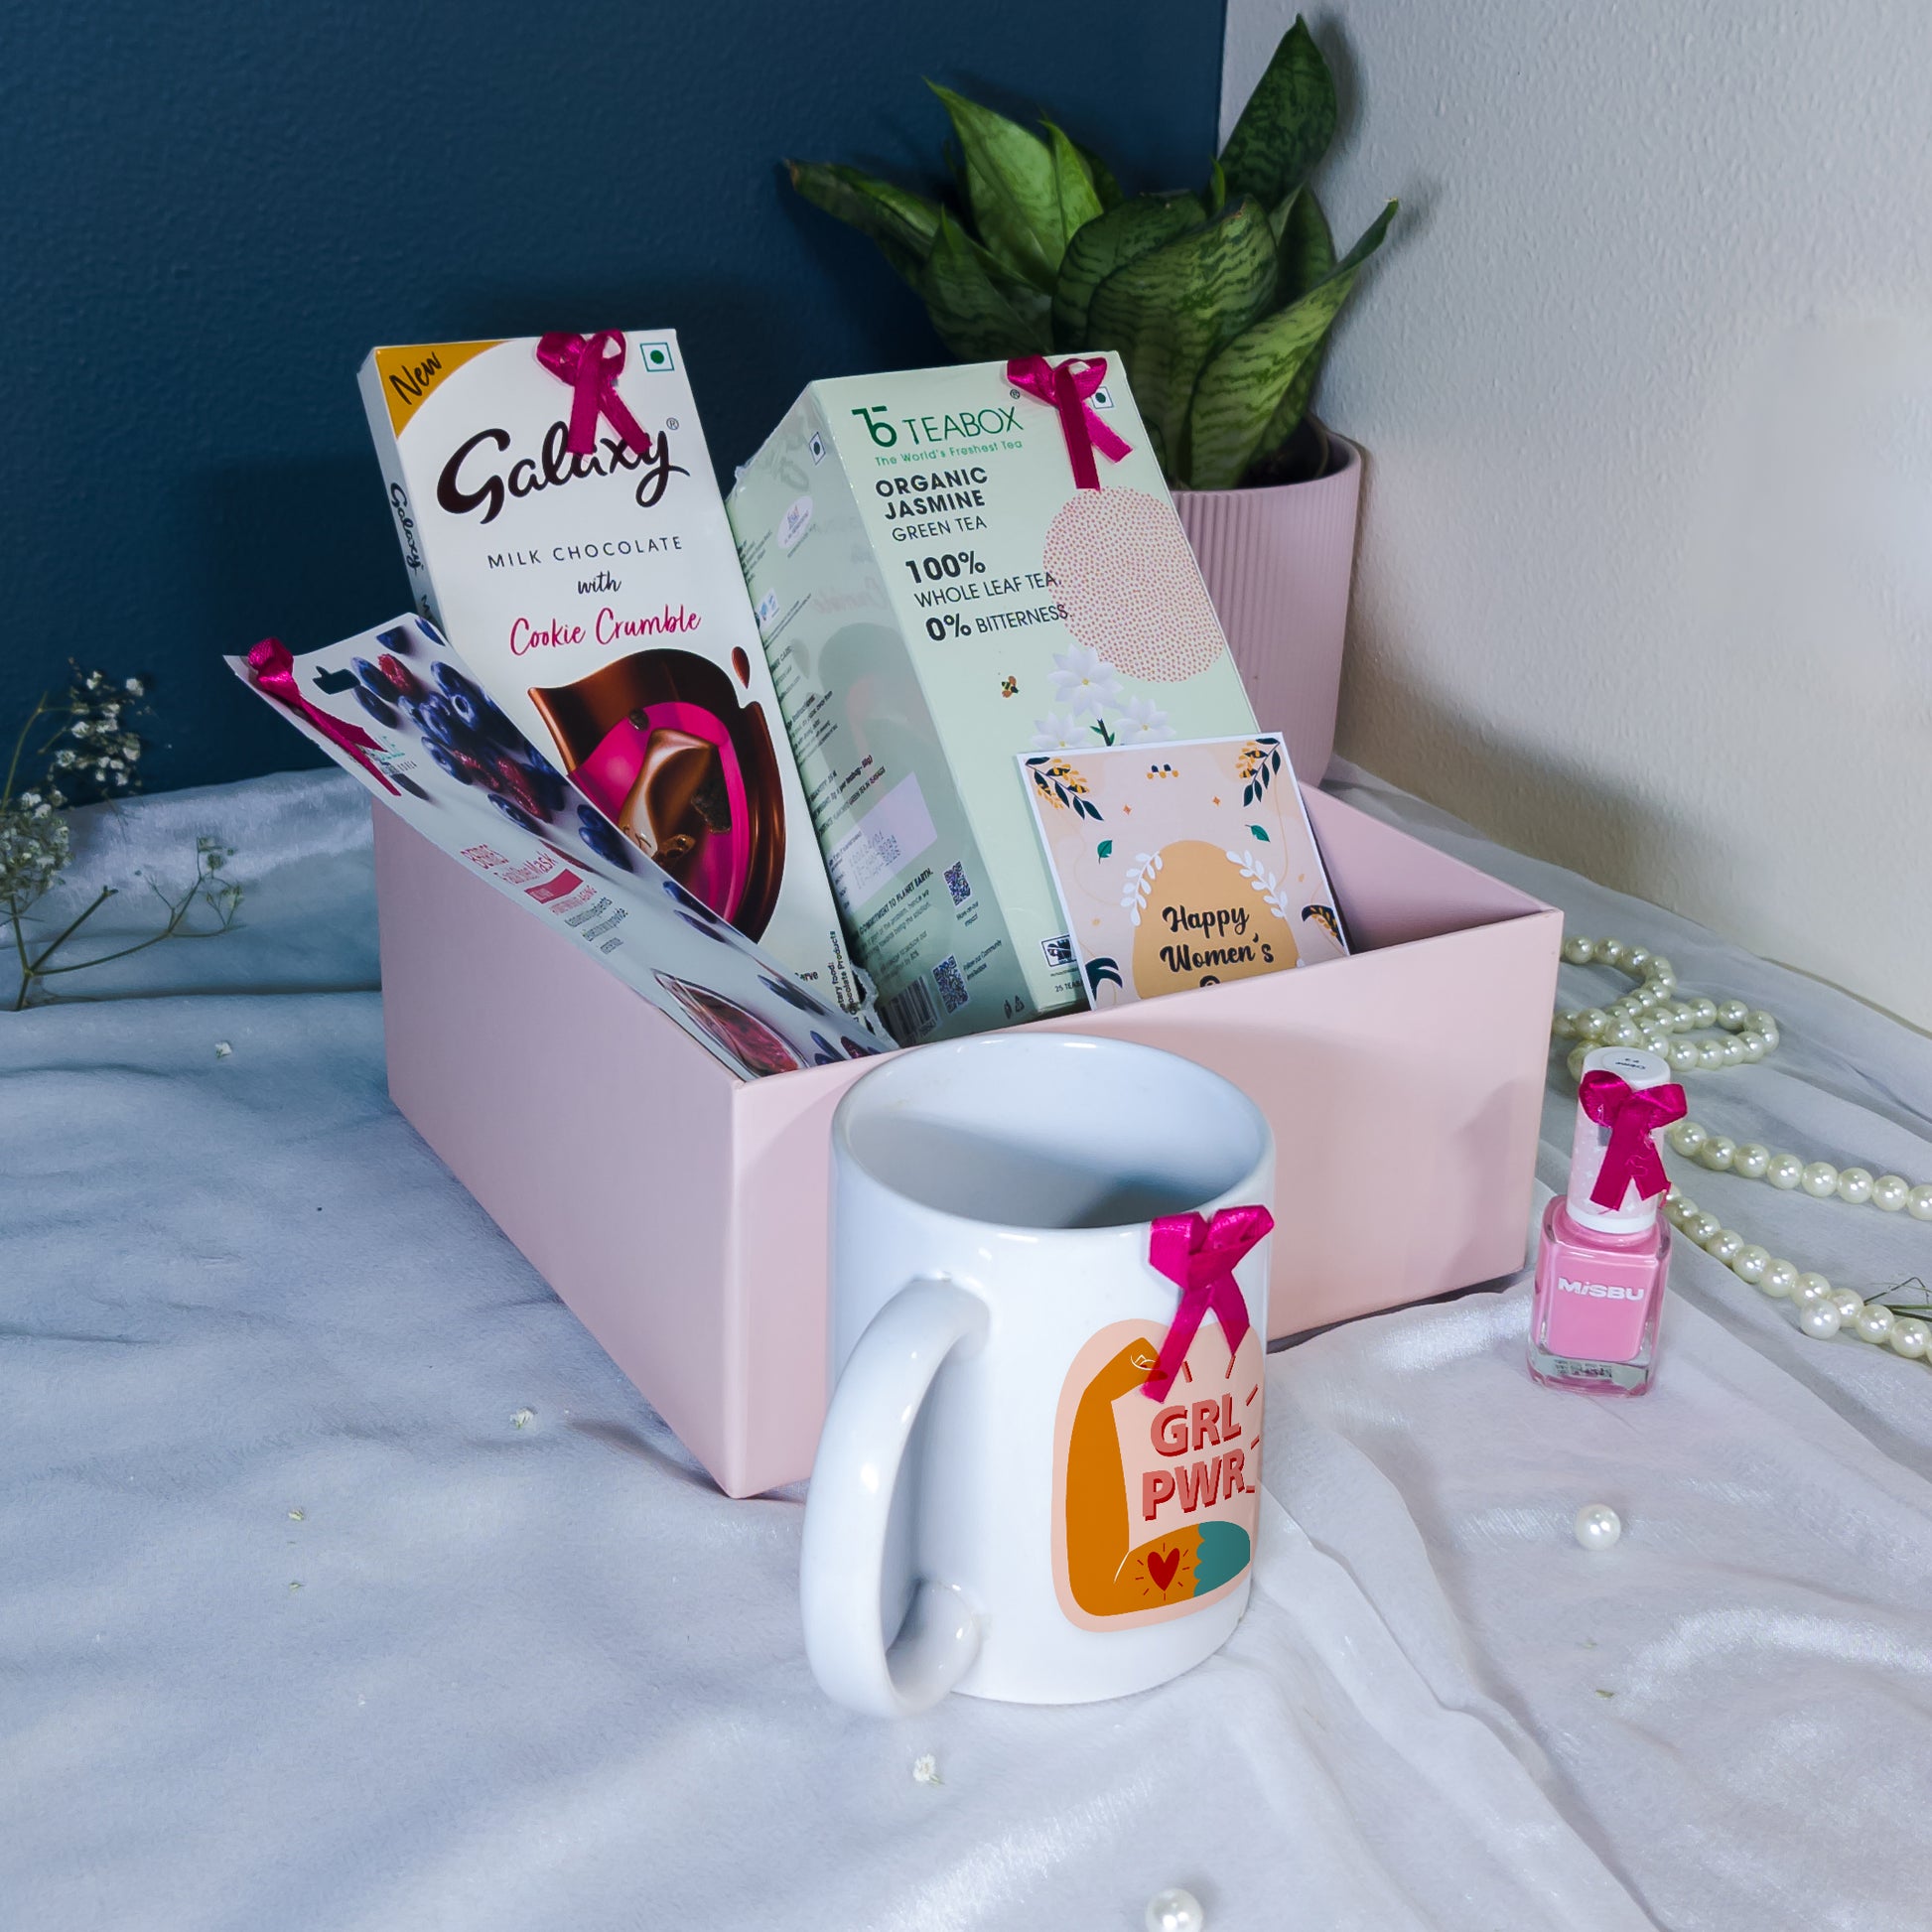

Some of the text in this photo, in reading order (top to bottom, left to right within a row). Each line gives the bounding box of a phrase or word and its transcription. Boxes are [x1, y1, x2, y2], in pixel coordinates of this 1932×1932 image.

[389, 352, 442, 405] New
[901, 406, 1025, 446] TEABOX
[875, 439, 1023, 467] The World's Freshest Tea
[437, 421, 691, 525] Galaxy
[875, 467, 989, 497] ORGANIC
[884, 489, 986, 520] JASMINE
[390, 483, 425, 576] Galaxy
[892, 515, 988, 542] GREEN TEA
[487, 536, 684, 569] MILK CHOCOLATE
[904, 550, 987, 584] 100%
[578, 571, 622, 595] with
[913, 583, 980, 609] WHOLE
[983, 577, 1023, 598] LEAF
[509, 605, 702, 656] Cookie Crumble
[925, 614, 972, 641] 0%
[1163, 904, 1250, 939] Happy
[1160, 932, 1275, 973] Women's
[1150, 1393, 1242, 1457] GRL
